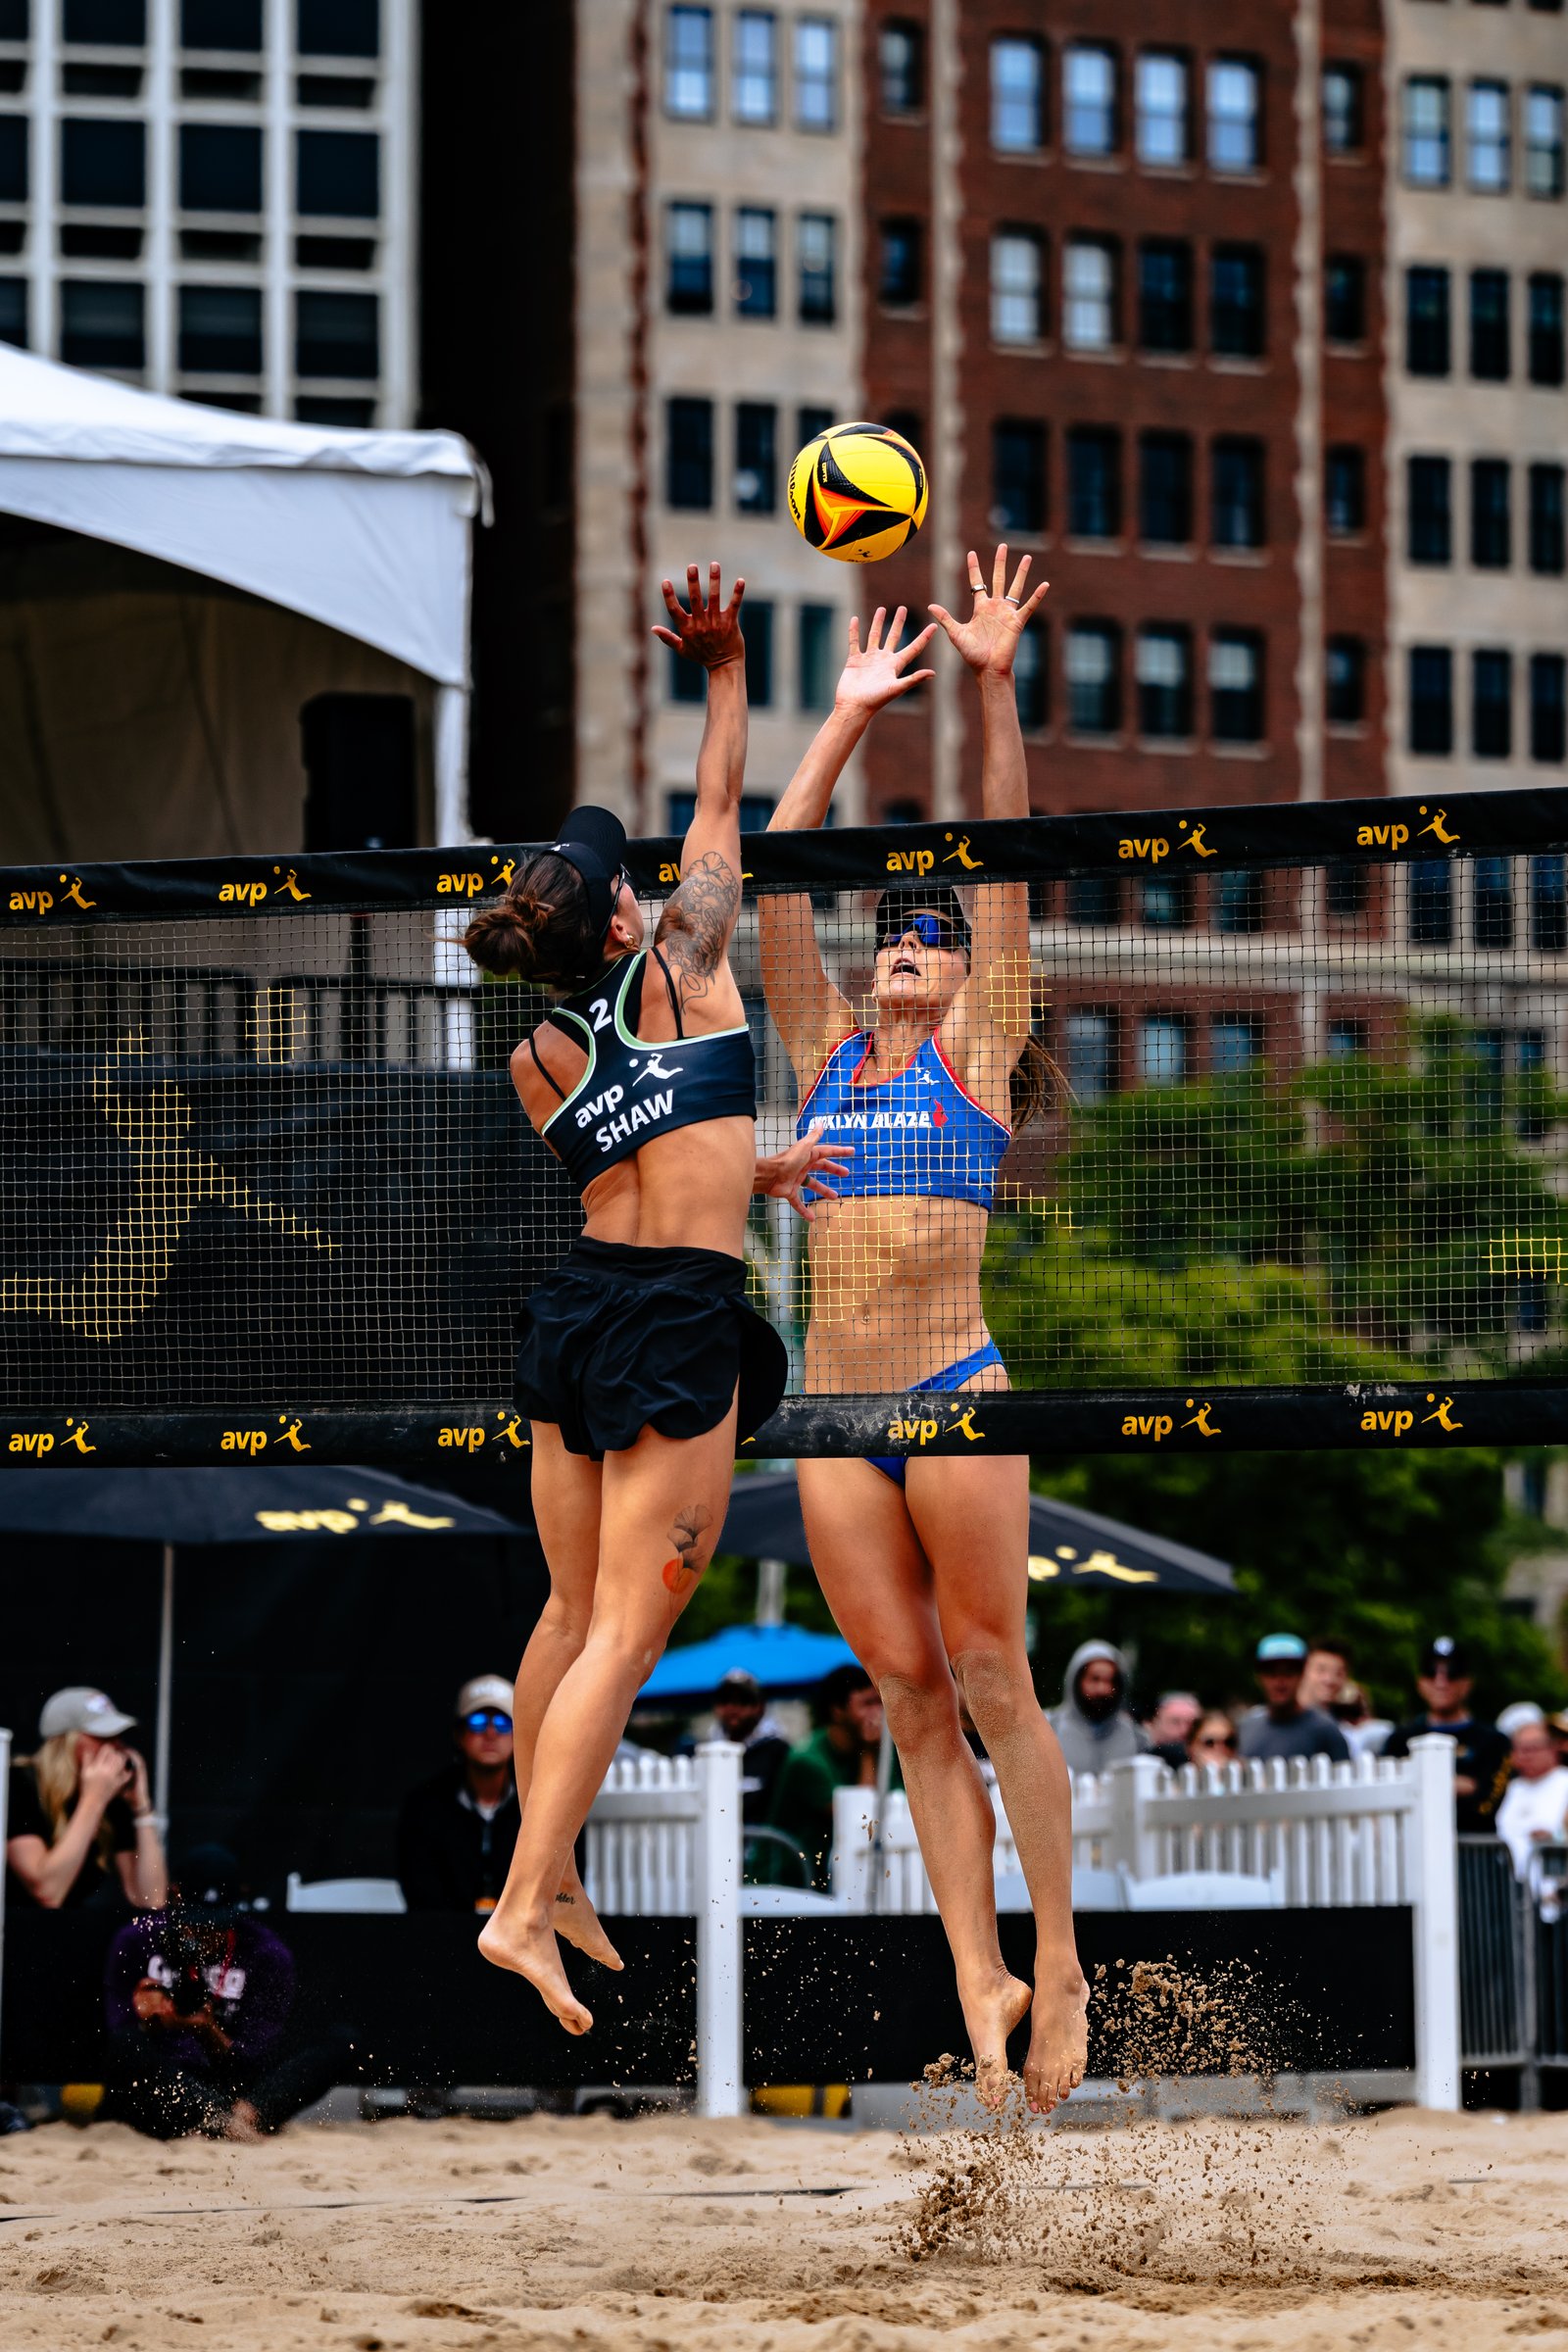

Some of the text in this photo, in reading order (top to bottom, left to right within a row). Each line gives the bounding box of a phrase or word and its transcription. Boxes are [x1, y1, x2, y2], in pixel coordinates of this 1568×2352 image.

[1357, 824, 1409, 850] avp
[886, 850, 934, 876] avp
[1118, 838, 1169, 863] avp
[219, 882, 267, 906] avp
[437, 872, 484, 897] avp
[9, 891, 54, 914] avp
[589, 998, 612, 1033] 2
[574, 1084, 624, 1129] avp
[595, 1089, 674, 1152] SHAW
[888, 1419, 938, 1446] avp
[1122, 1415, 1173, 1442] avp
[1361, 1410, 1414, 1437] avp
[9, 1433, 54, 1457] avp
[220, 1431, 268, 1455] avp
[438, 1427, 485, 1452] avp
